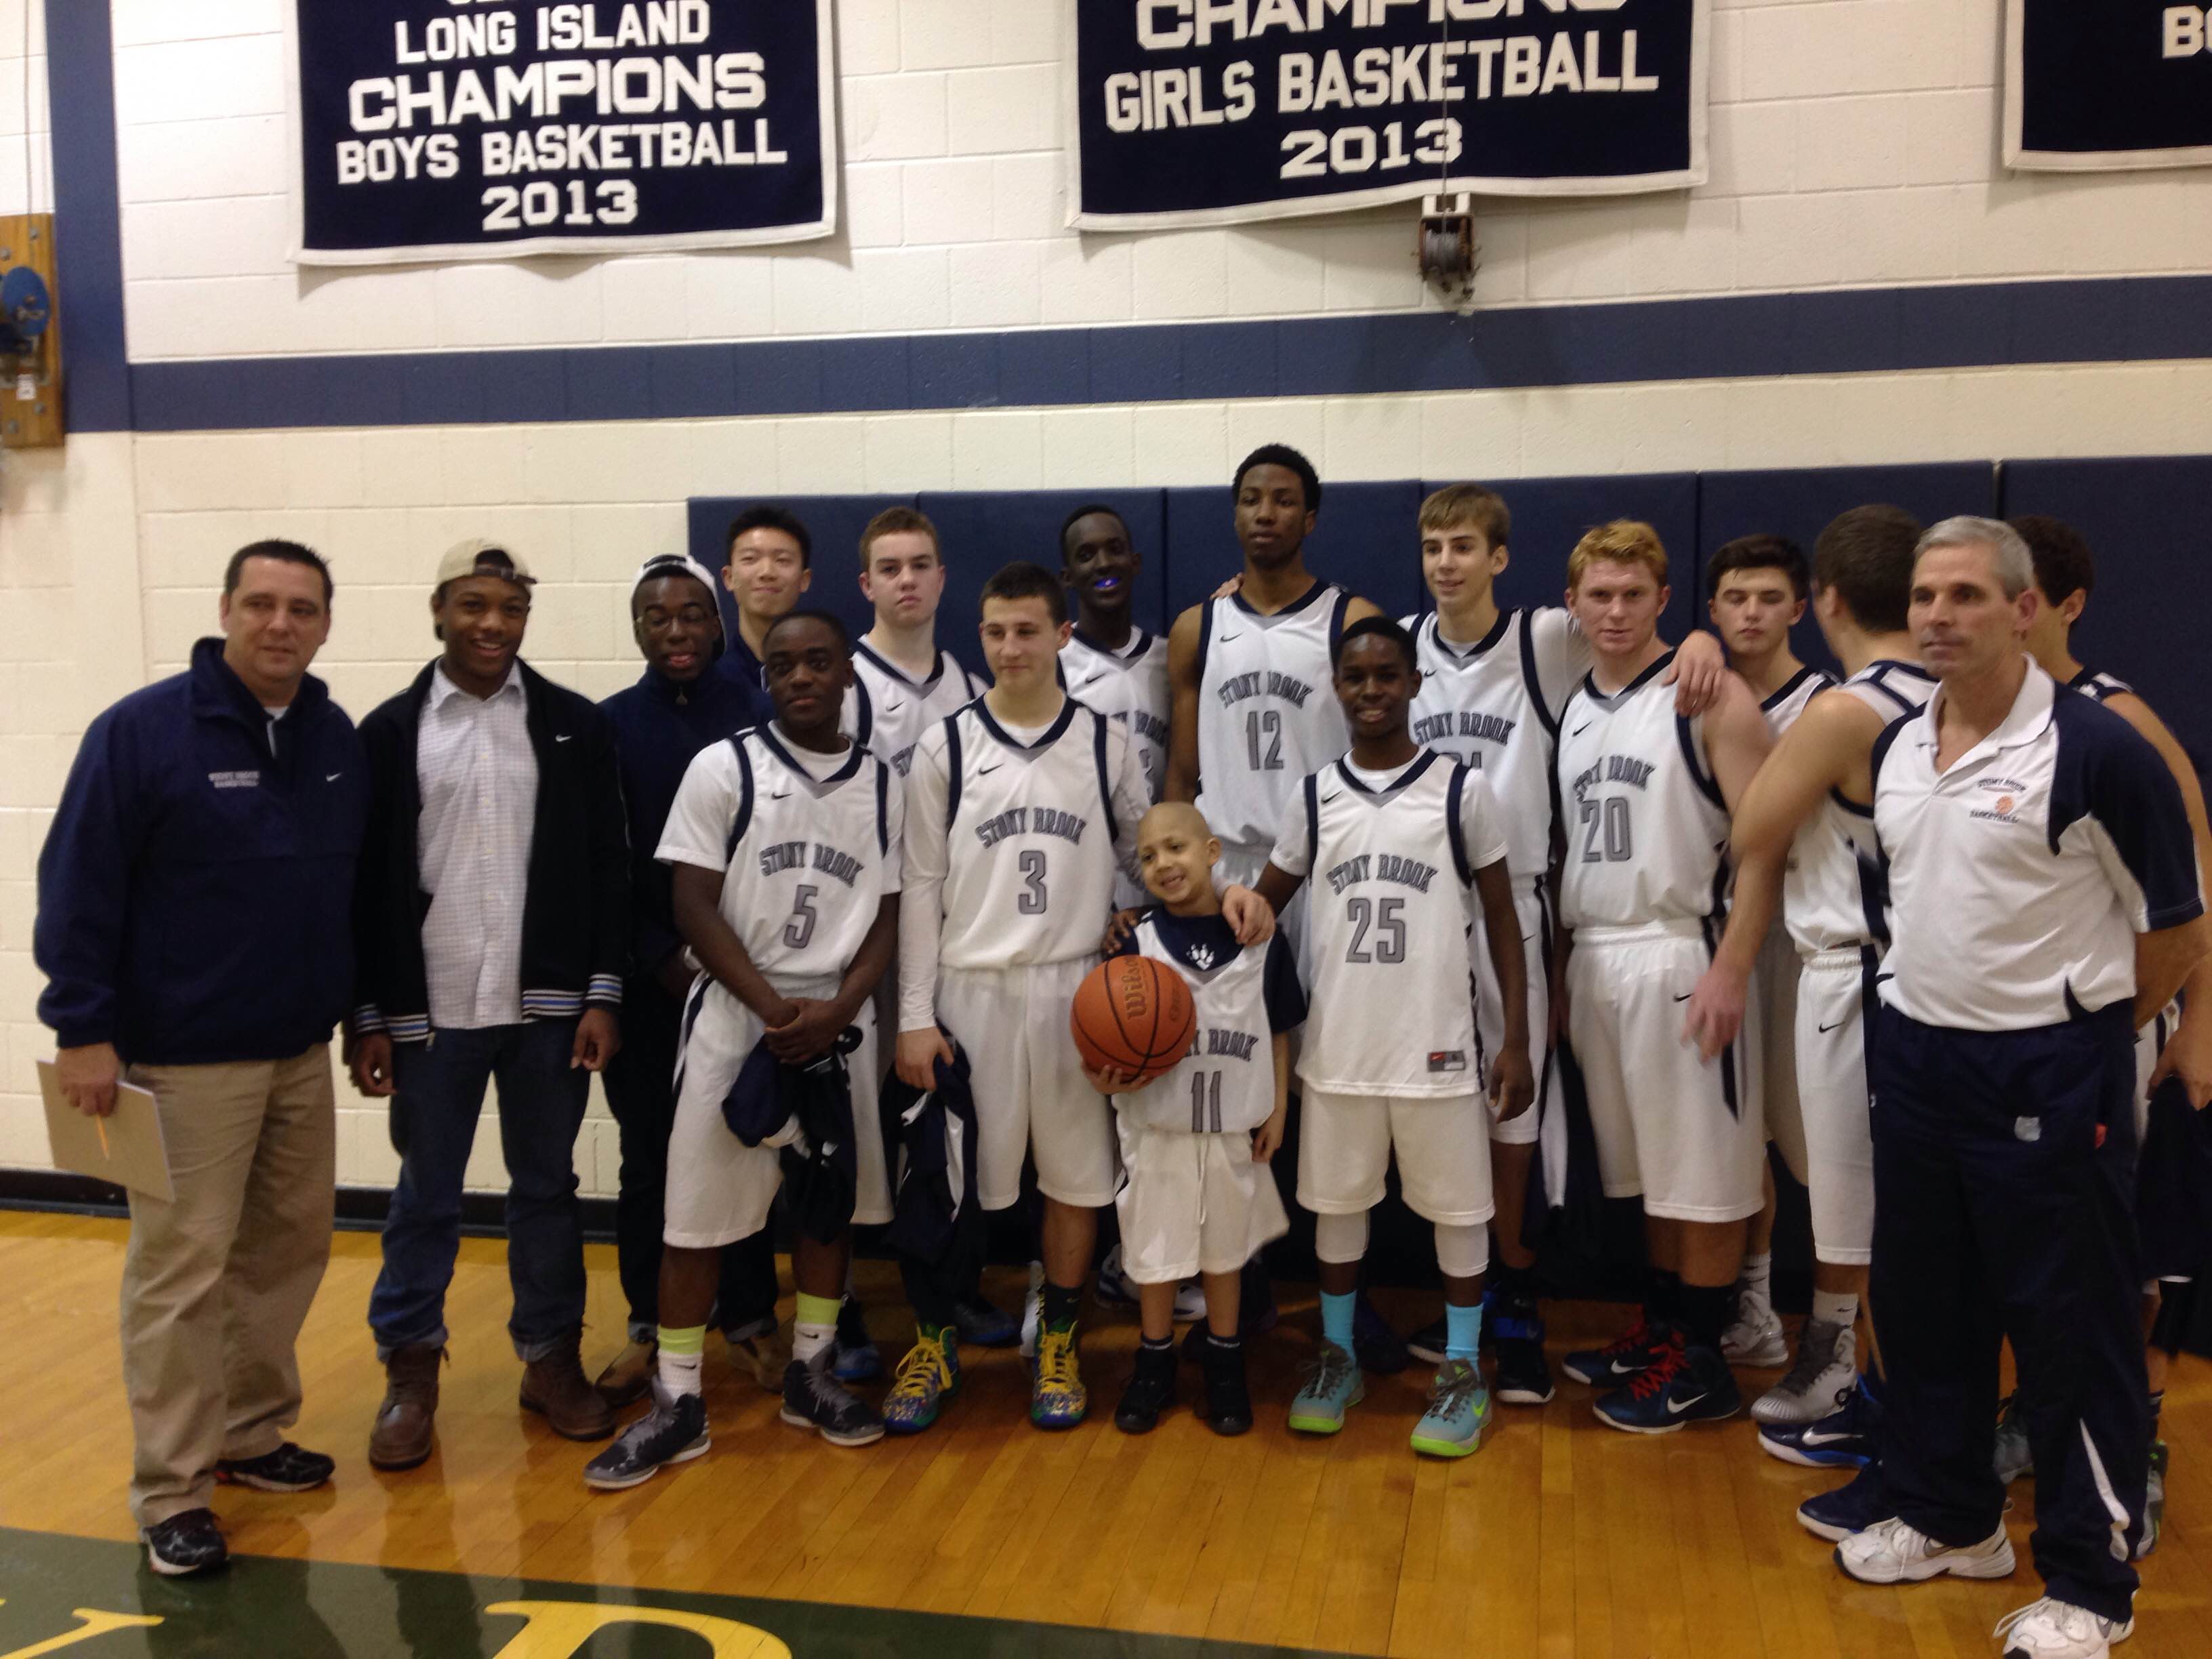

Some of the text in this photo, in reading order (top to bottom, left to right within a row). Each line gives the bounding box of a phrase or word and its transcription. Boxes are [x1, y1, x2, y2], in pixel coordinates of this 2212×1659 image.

[394, 0, 710, 64] LONG ISLAND
[1136, 0, 1628, 50] CHAMP
[2163, 5, 2212, 58] B
[348, 52, 766, 133] CHAMPIONS
[1104, 30, 1660, 134] GIRLS BASKETBALL
[336, 118, 788, 184] BOYS BASKETBALL
[1279, 117, 1463, 180] 2013
[481, 179, 638, 231] 2013
[1245, 710, 1284, 771] 12
[1413, 712, 1516, 746] STONY BROOK
[1573, 754, 1603, 802] STOY
[759, 841, 806, 877] STONY
[975, 806, 1086, 849] STONY BROOK
[1580, 796, 1632, 863] 20
[1018, 850, 1047, 915] 3
[1326, 854, 1439, 896] STONY BROOK
[783, 884, 818, 949] 5
[1345, 897, 1406, 964] 25
[1122, 956, 1147, 1021] Wilso
[1191, 1070, 1222, 1133] 11
